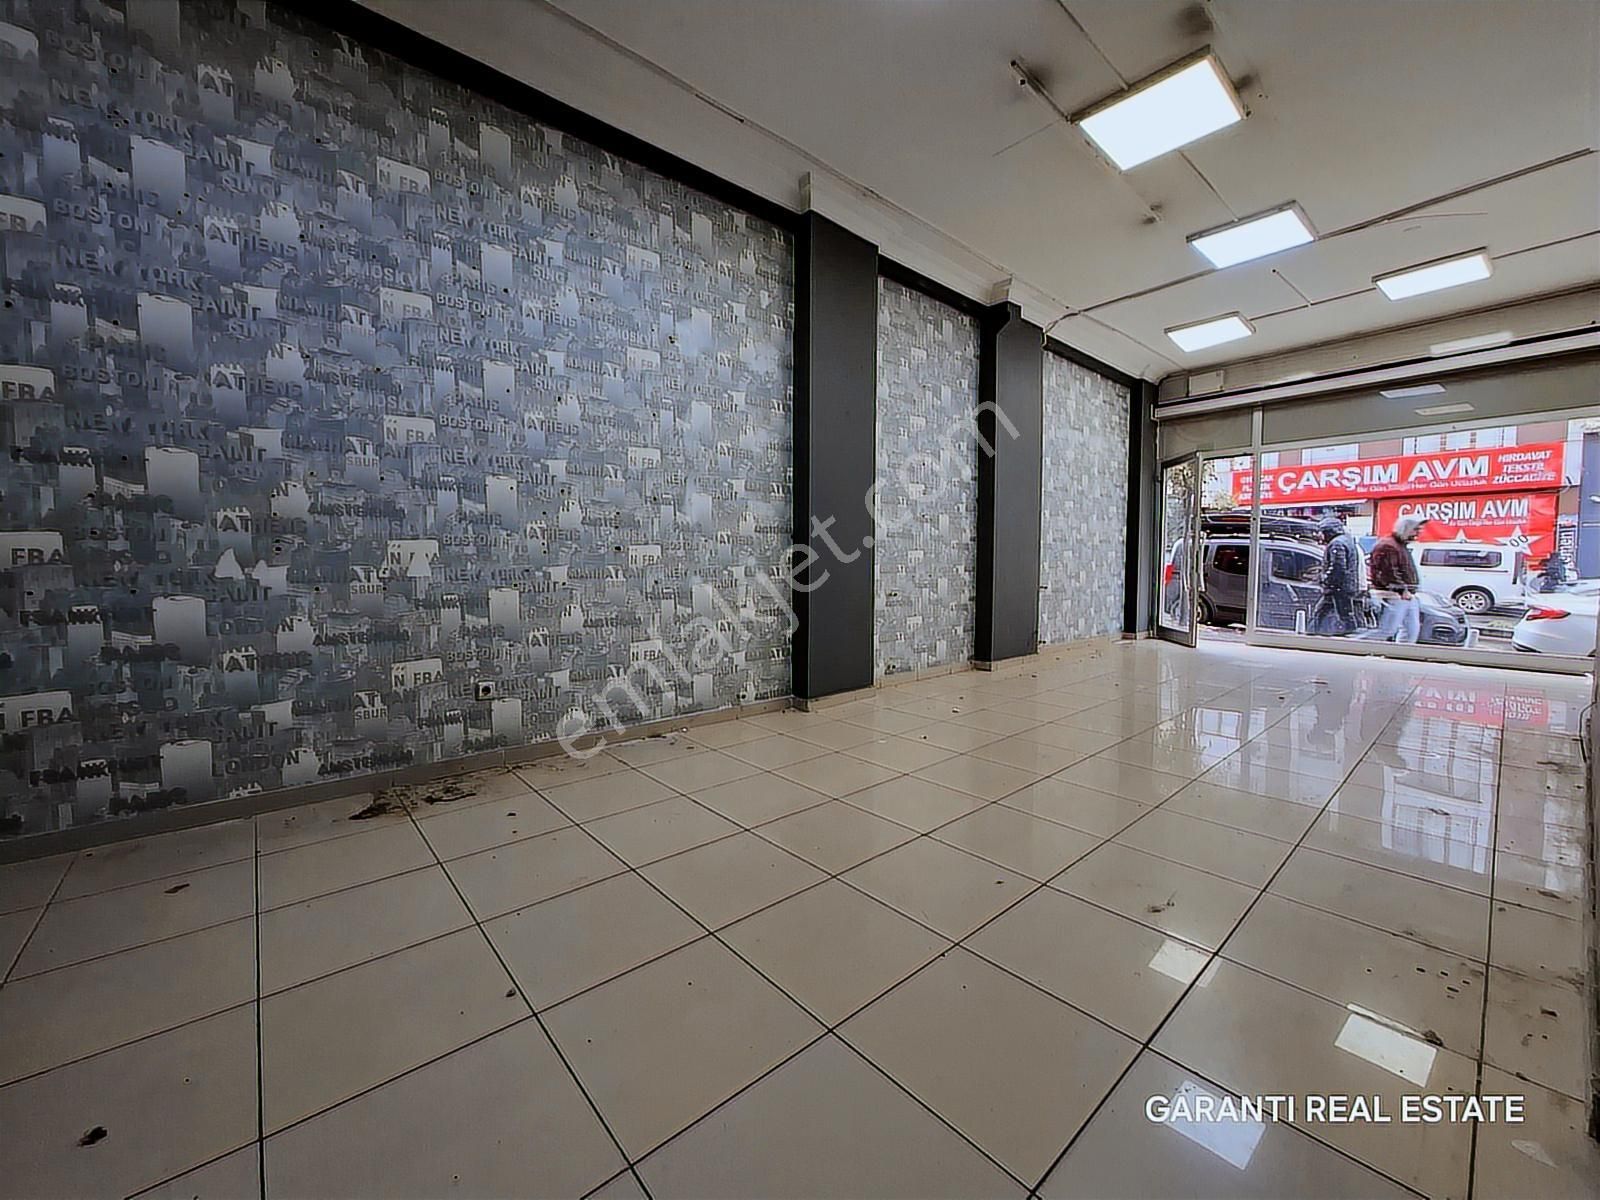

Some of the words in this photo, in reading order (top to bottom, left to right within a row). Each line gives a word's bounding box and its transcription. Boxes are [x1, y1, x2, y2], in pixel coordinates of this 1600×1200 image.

[2, 381, 55, 401] FRA
[1277, 463, 1399, 495] ÇARŞIM
[1407, 454, 1490, 482] AVM
[1481, 498, 1530, 517] AVM
[11, 548, 64, 565] FRA
[21, 707, 74, 728] FRA
